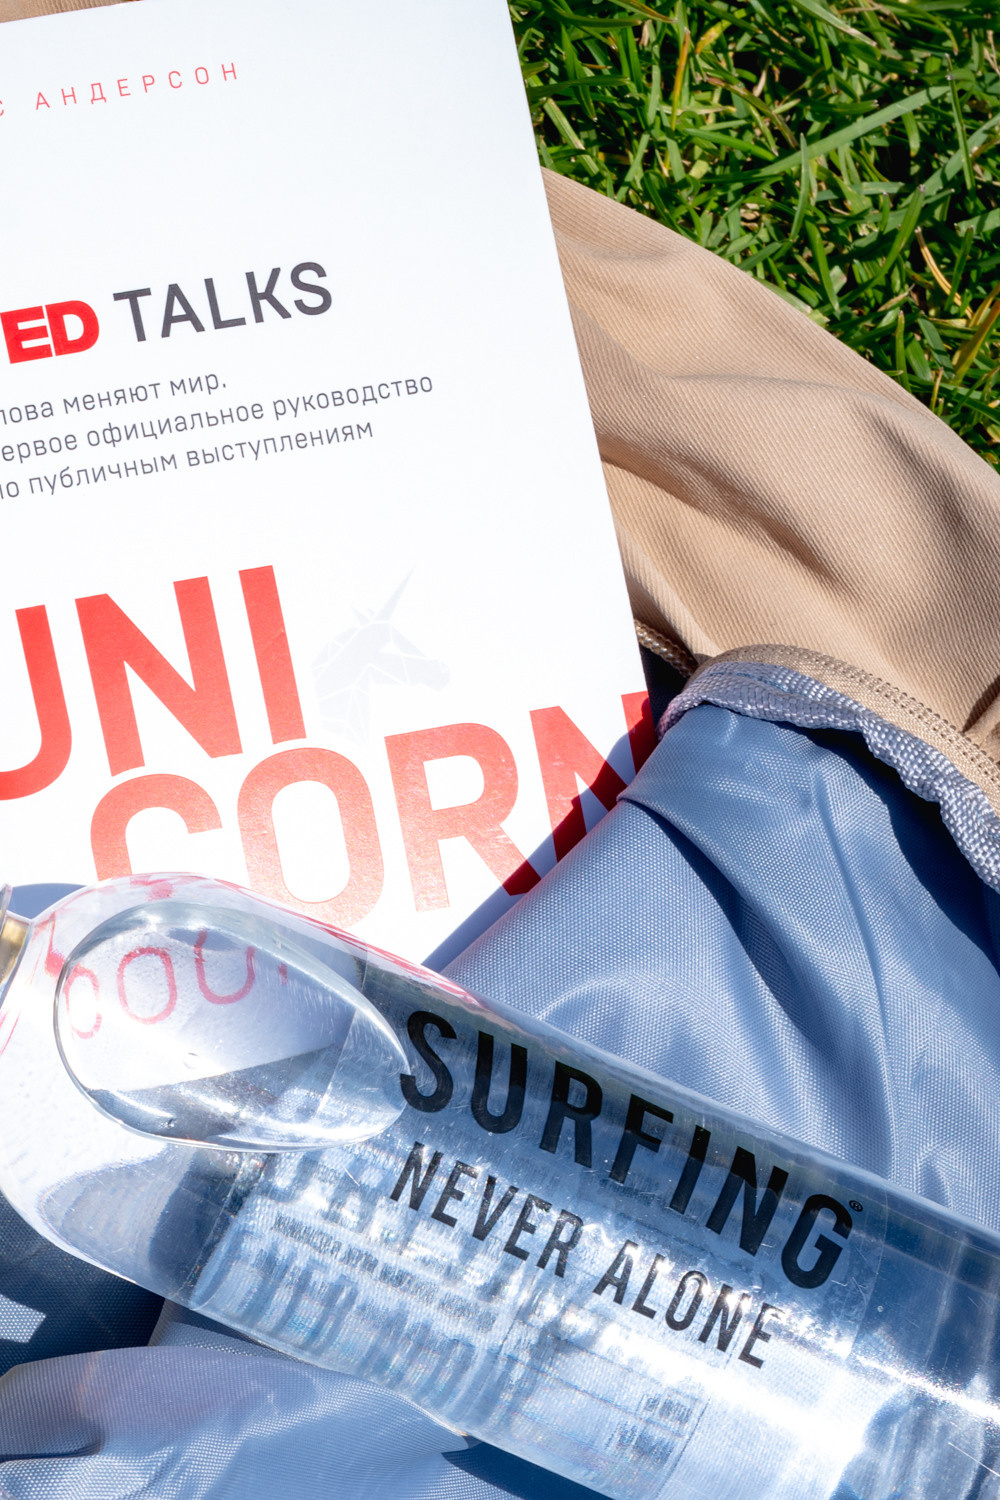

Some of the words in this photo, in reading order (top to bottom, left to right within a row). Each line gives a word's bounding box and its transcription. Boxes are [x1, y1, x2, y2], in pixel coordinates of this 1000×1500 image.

[35, 61, 238, 111] АНДЕРСОН
[112, 261, 332, 343] TALKS
[62, 383, 161, 415] меняют
[169, 373, 228, 397] мир.
[86, 403, 264, 448] официальное
[272, 376, 433, 421] руководство
[28, 453, 178, 496] публичным
[186, 421, 373, 467] выступлениям
[399, 1010, 853, 1290] SURFING
[389, 1140, 585, 1279] NEVER
[593, 1239, 785, 1368] ALONE
